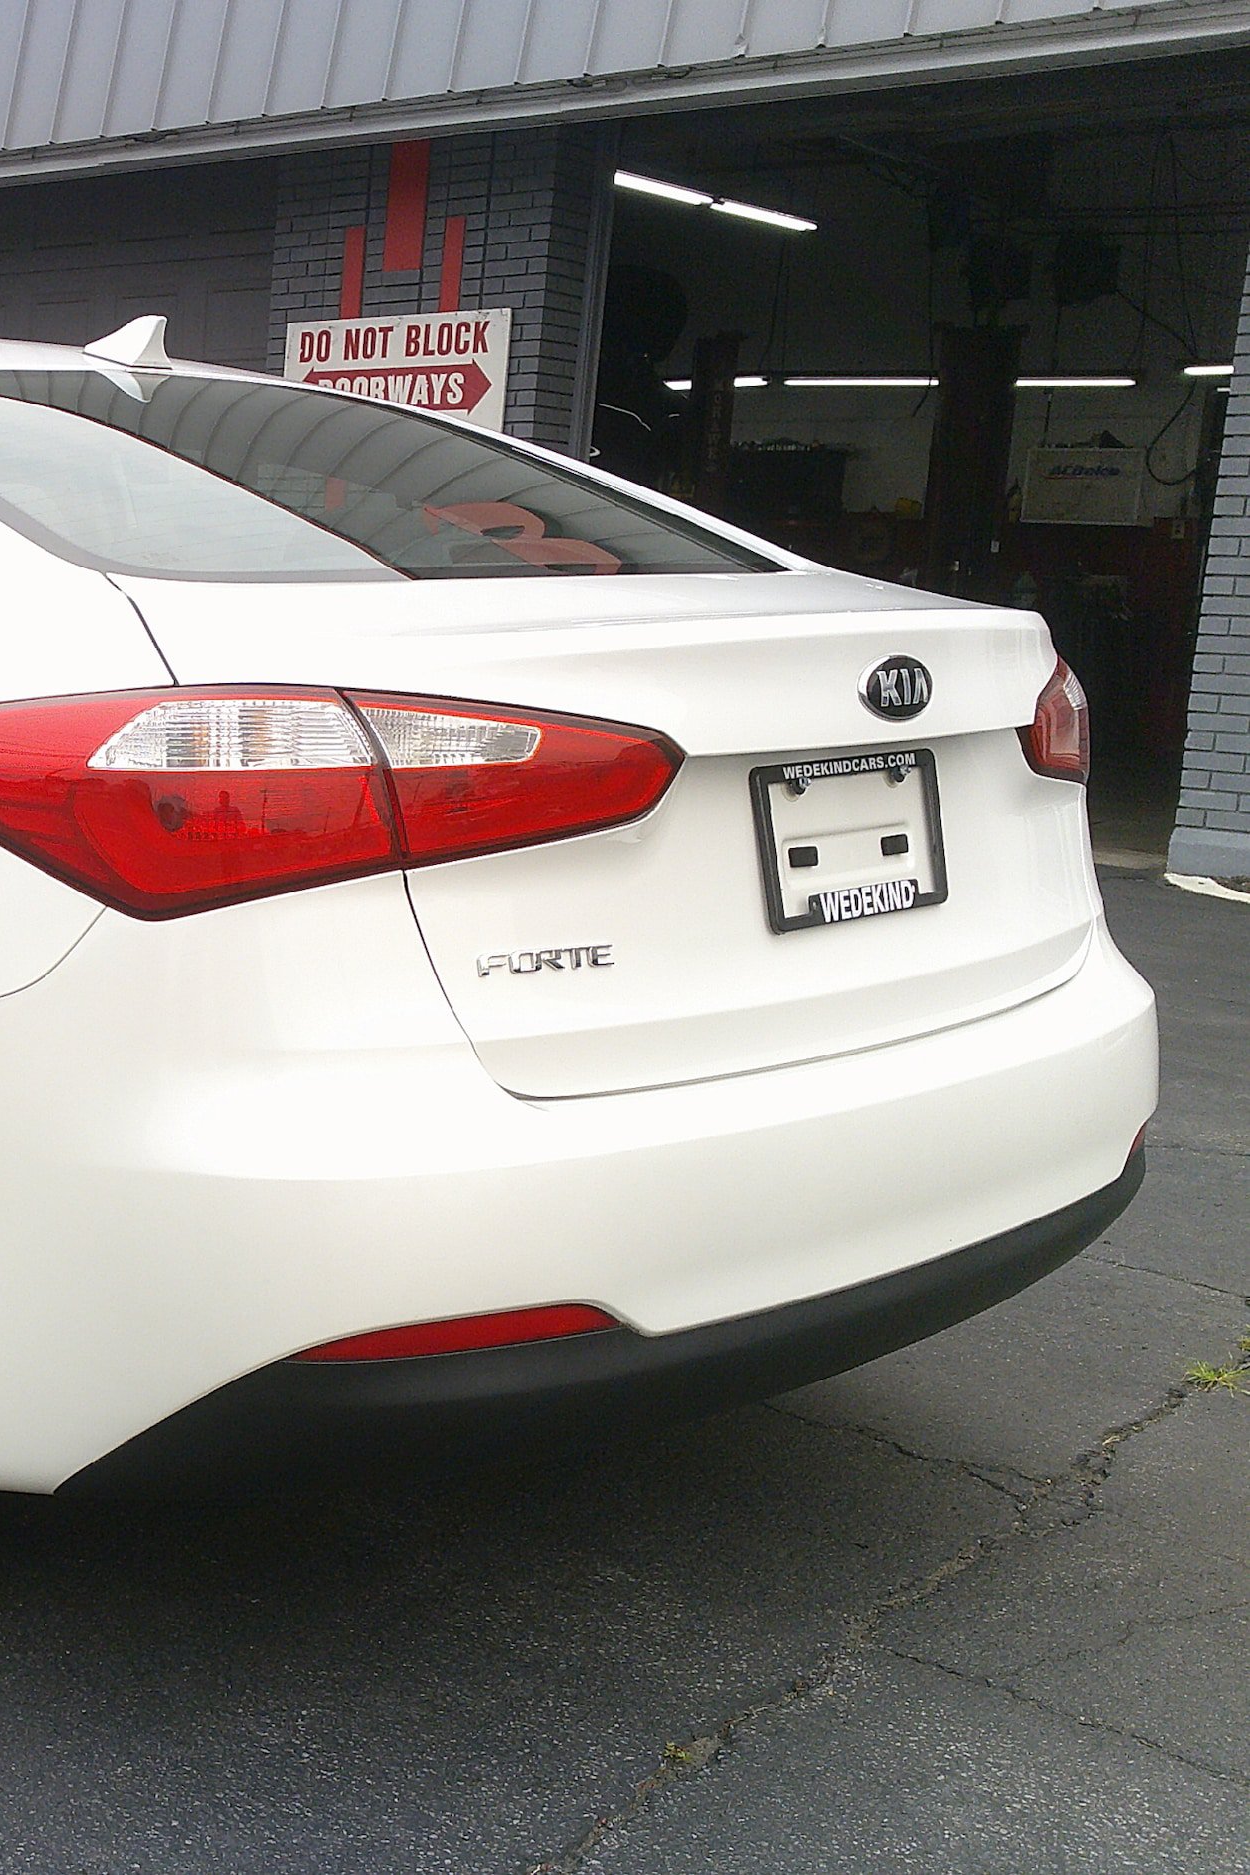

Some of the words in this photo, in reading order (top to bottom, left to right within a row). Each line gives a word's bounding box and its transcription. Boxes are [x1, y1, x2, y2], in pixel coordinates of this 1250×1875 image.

[299, 330, 331, 363] DO
[343, 325, 394, 361] NOT
[404, 321, 491, 358] BLOCK
[318, 372, 465, 405] ORWAYS
[876, 667, 929, 707] KIA
[783, 752, 916, 780] WEDEKINDCARS.COM
[819, 880, 915, 923] WEDEKIND
[477, 944, 614, 978] FORTE
